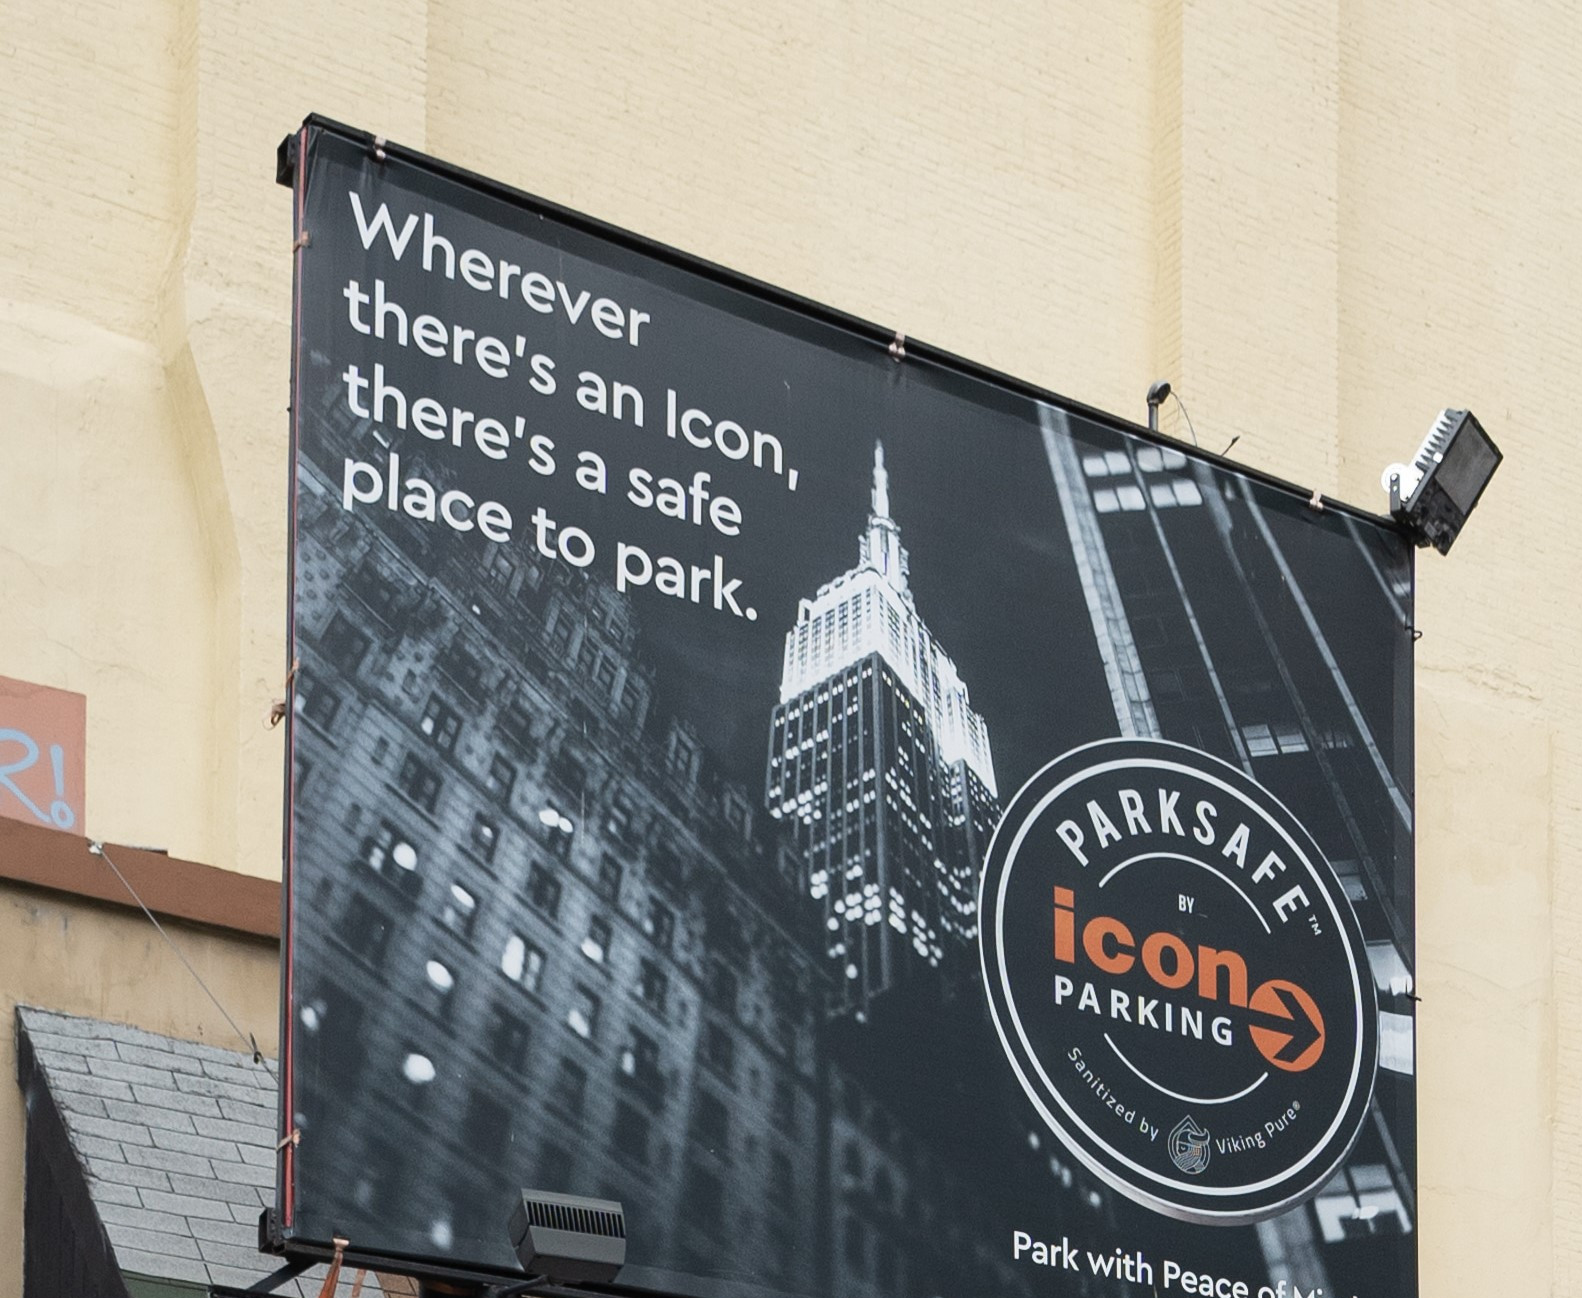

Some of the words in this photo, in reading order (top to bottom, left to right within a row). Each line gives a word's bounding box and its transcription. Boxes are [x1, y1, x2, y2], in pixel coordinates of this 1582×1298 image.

[349, 191, 650, 347] Wherever
[343, 279, 557, 396] there's
[576, 370, 644, 427] an
[667, 389, 800, 491] Icon,
[343, 363, 557, 476] there's
[576, 450, 607, 494] a
[627, 472, 742, 536] safe
[343, 454, 513, 543] place
[532, 506, 596, 568] to
[616, 541, 758, 622] park.
[1054, 885, 1248, 1009] icon
[1178, 894, 1195, 914] BY
[1055, 975, 1233, 1046] PARKING
[1067, 1047, 1137, 1124] Sanitized
[1140, 1117, 1159, 1141] by
[1216, 1132, 1266, 1154] Viking
[1013, 1230, 1079, 1272] Park
[1087, 1248, 1153, 1285] with
